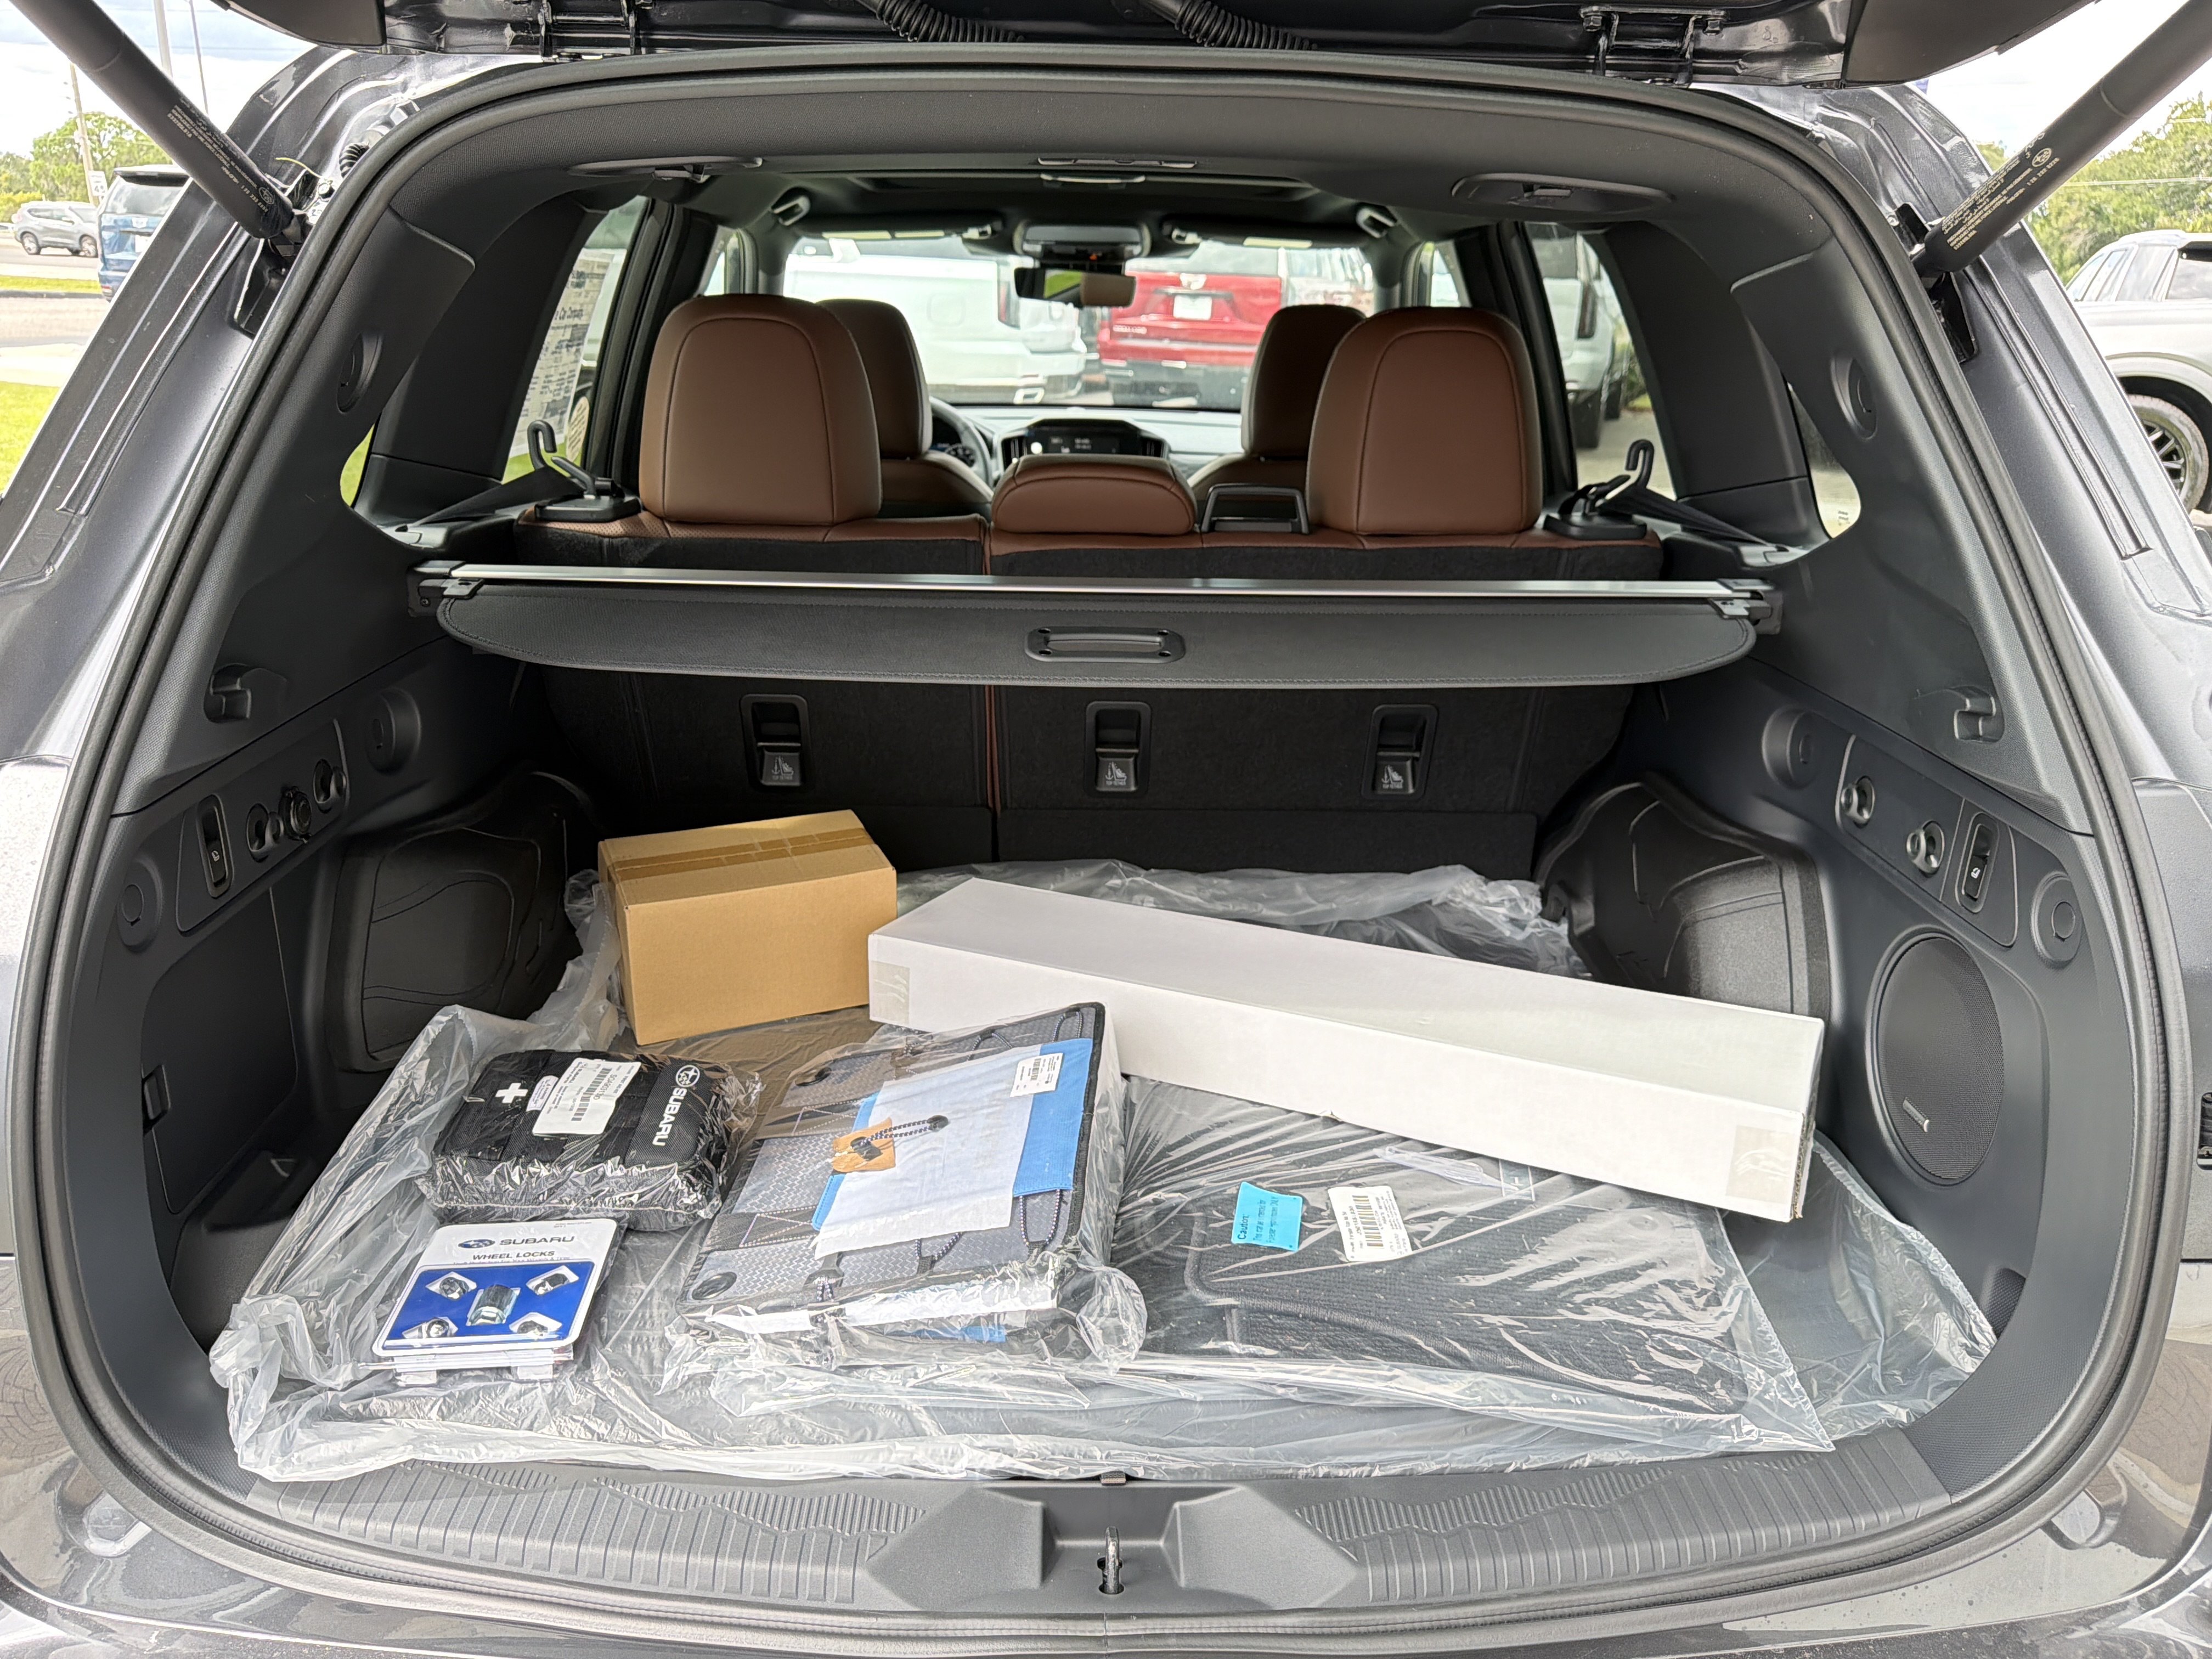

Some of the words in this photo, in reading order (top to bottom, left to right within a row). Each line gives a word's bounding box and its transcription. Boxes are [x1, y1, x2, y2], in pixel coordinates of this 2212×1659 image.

[653, 1087, 687, 1146] SUBARU
[499, 1235, 575, 1246] SUBARU
[473, 1252, 513, 1261] WHEEL
